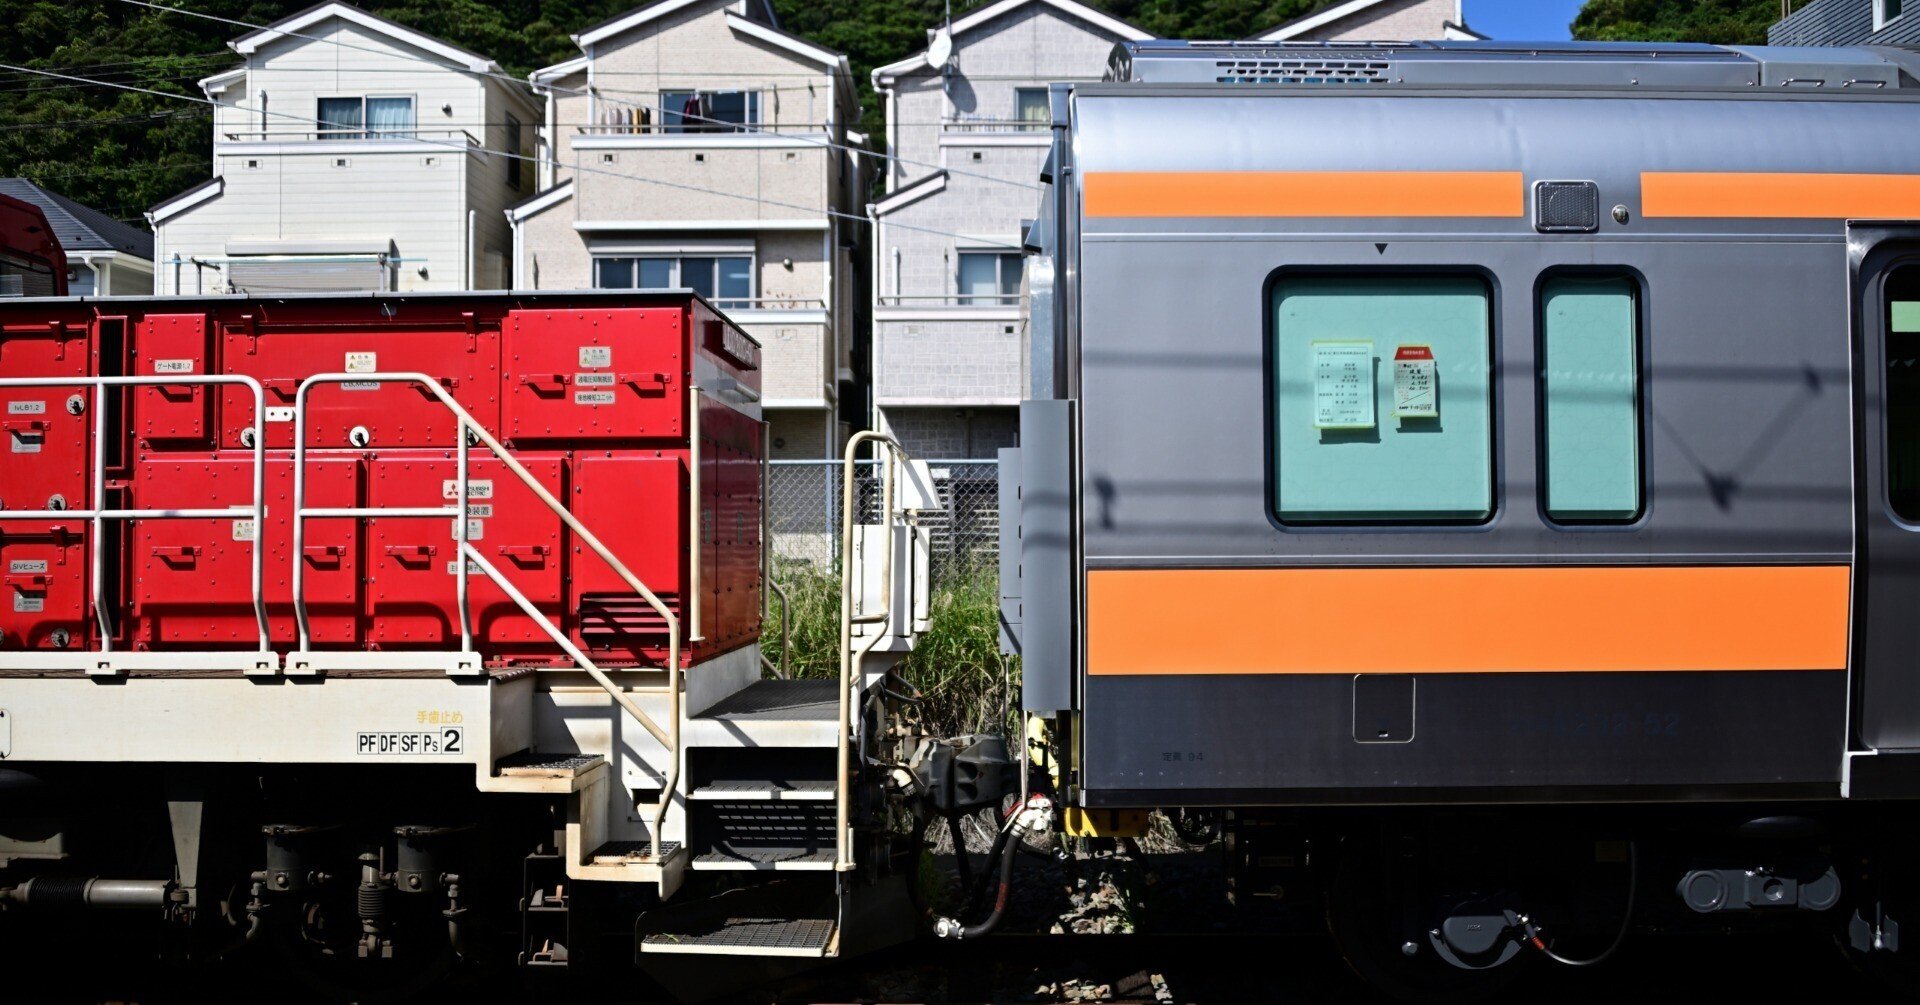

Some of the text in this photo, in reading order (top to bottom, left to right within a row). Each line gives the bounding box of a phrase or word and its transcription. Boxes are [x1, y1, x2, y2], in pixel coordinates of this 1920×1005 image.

[417, 710, 463, 724] 手歯止め
[359, 735, 377, 752] PF
[380, 735, 398, 752] DF
[401, 735, 419, 752] SF
[443, 729, 461, 752] 2
